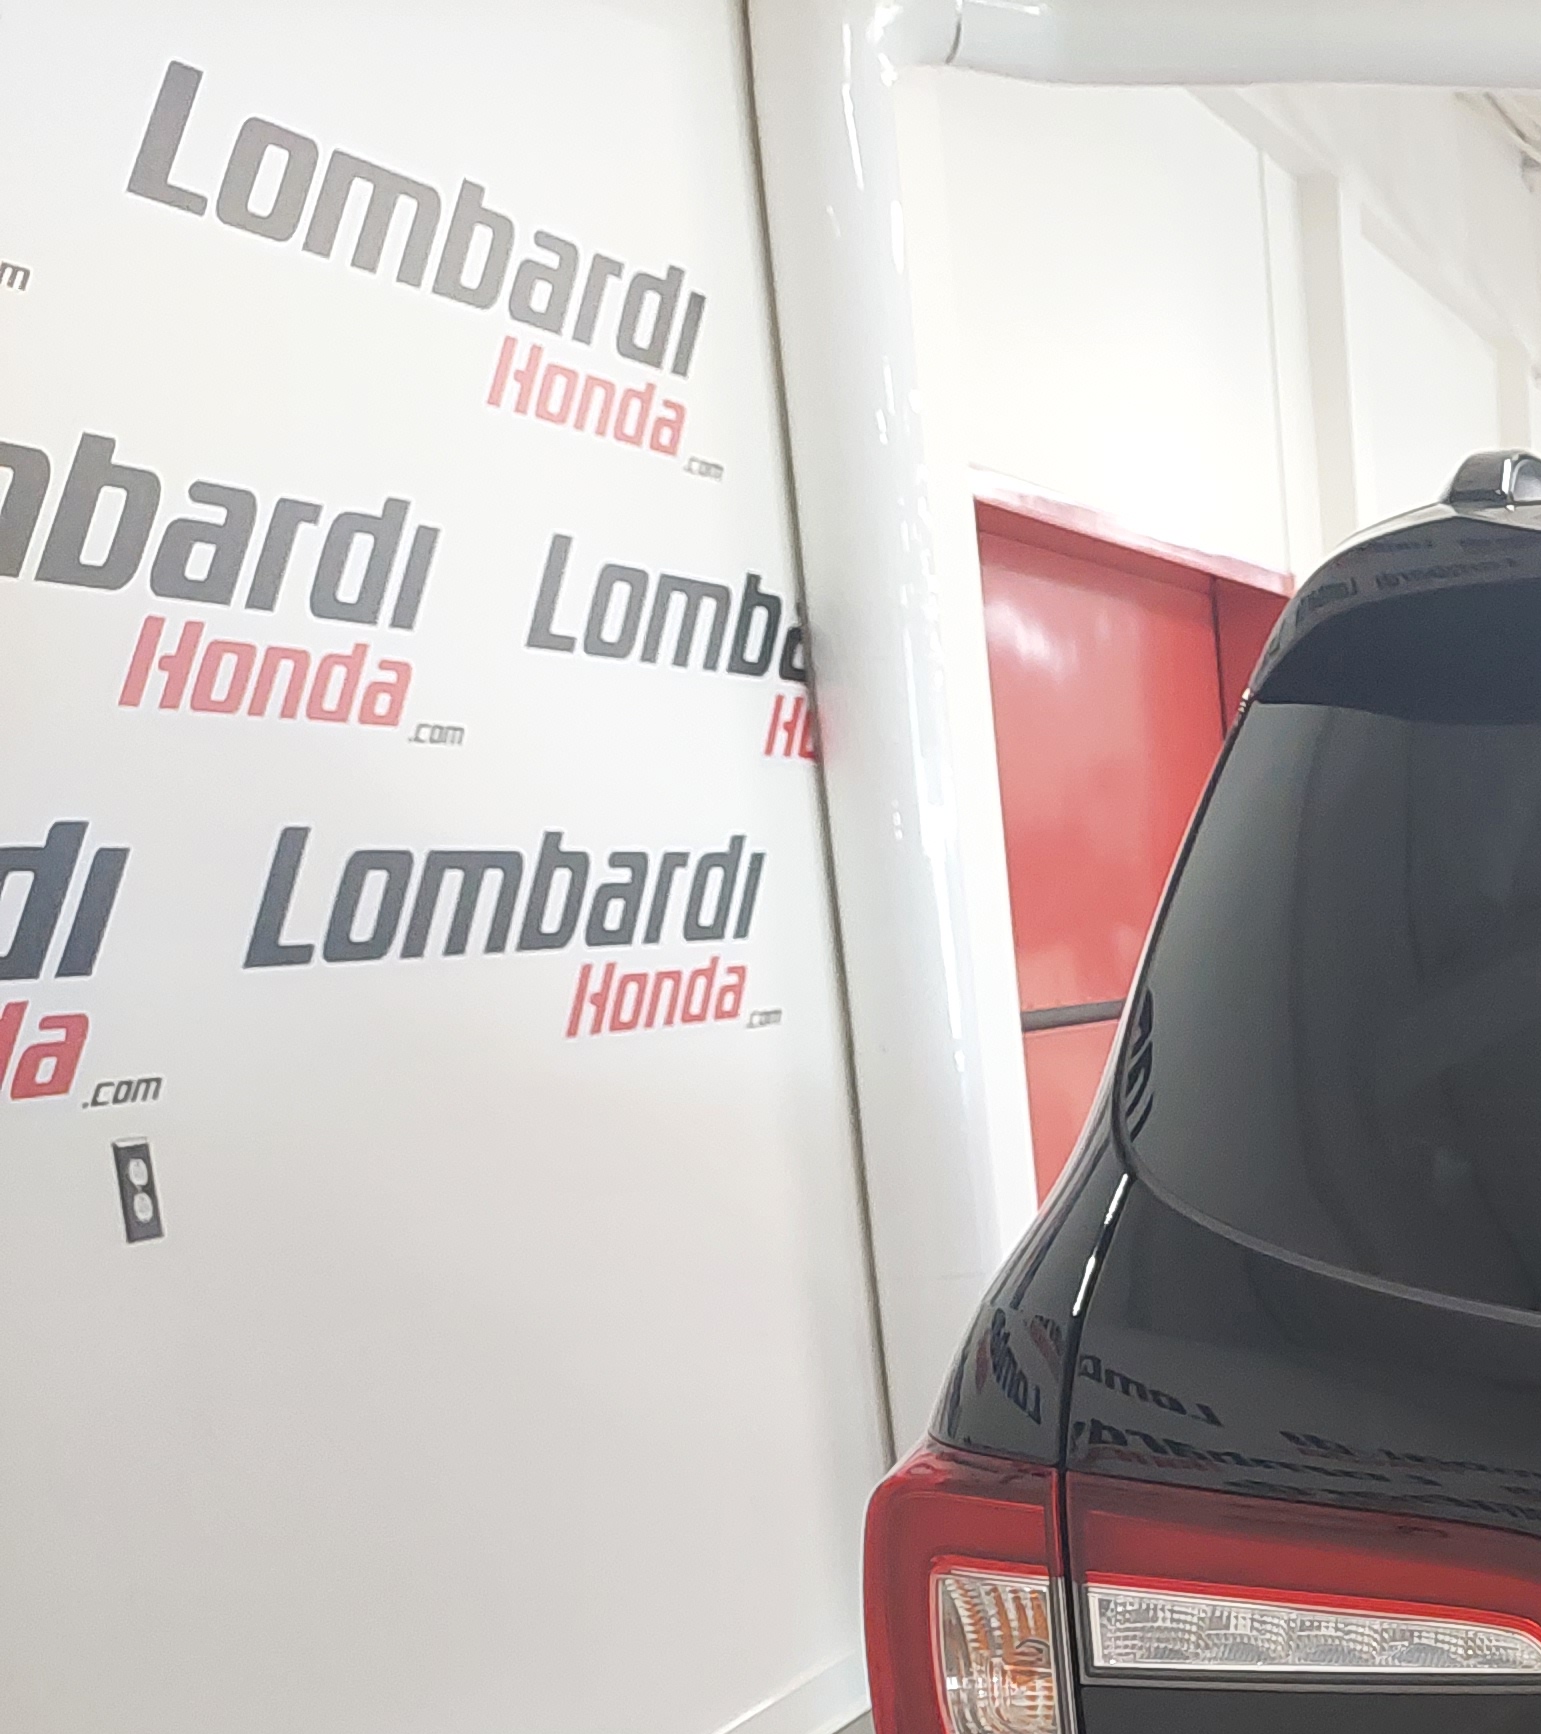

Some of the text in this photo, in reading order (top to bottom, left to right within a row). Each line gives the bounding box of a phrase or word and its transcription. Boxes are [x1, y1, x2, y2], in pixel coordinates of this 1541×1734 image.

[127, 61, 706, 377] Lombardi
[487, 336, 686, 456] Honda
[119, 615, 412, 727] Honda
[243, 827, 765, 969] Lombardi
[567, 957, 747, 1037] Honda
[82, 1077, 163, 1109] .com
